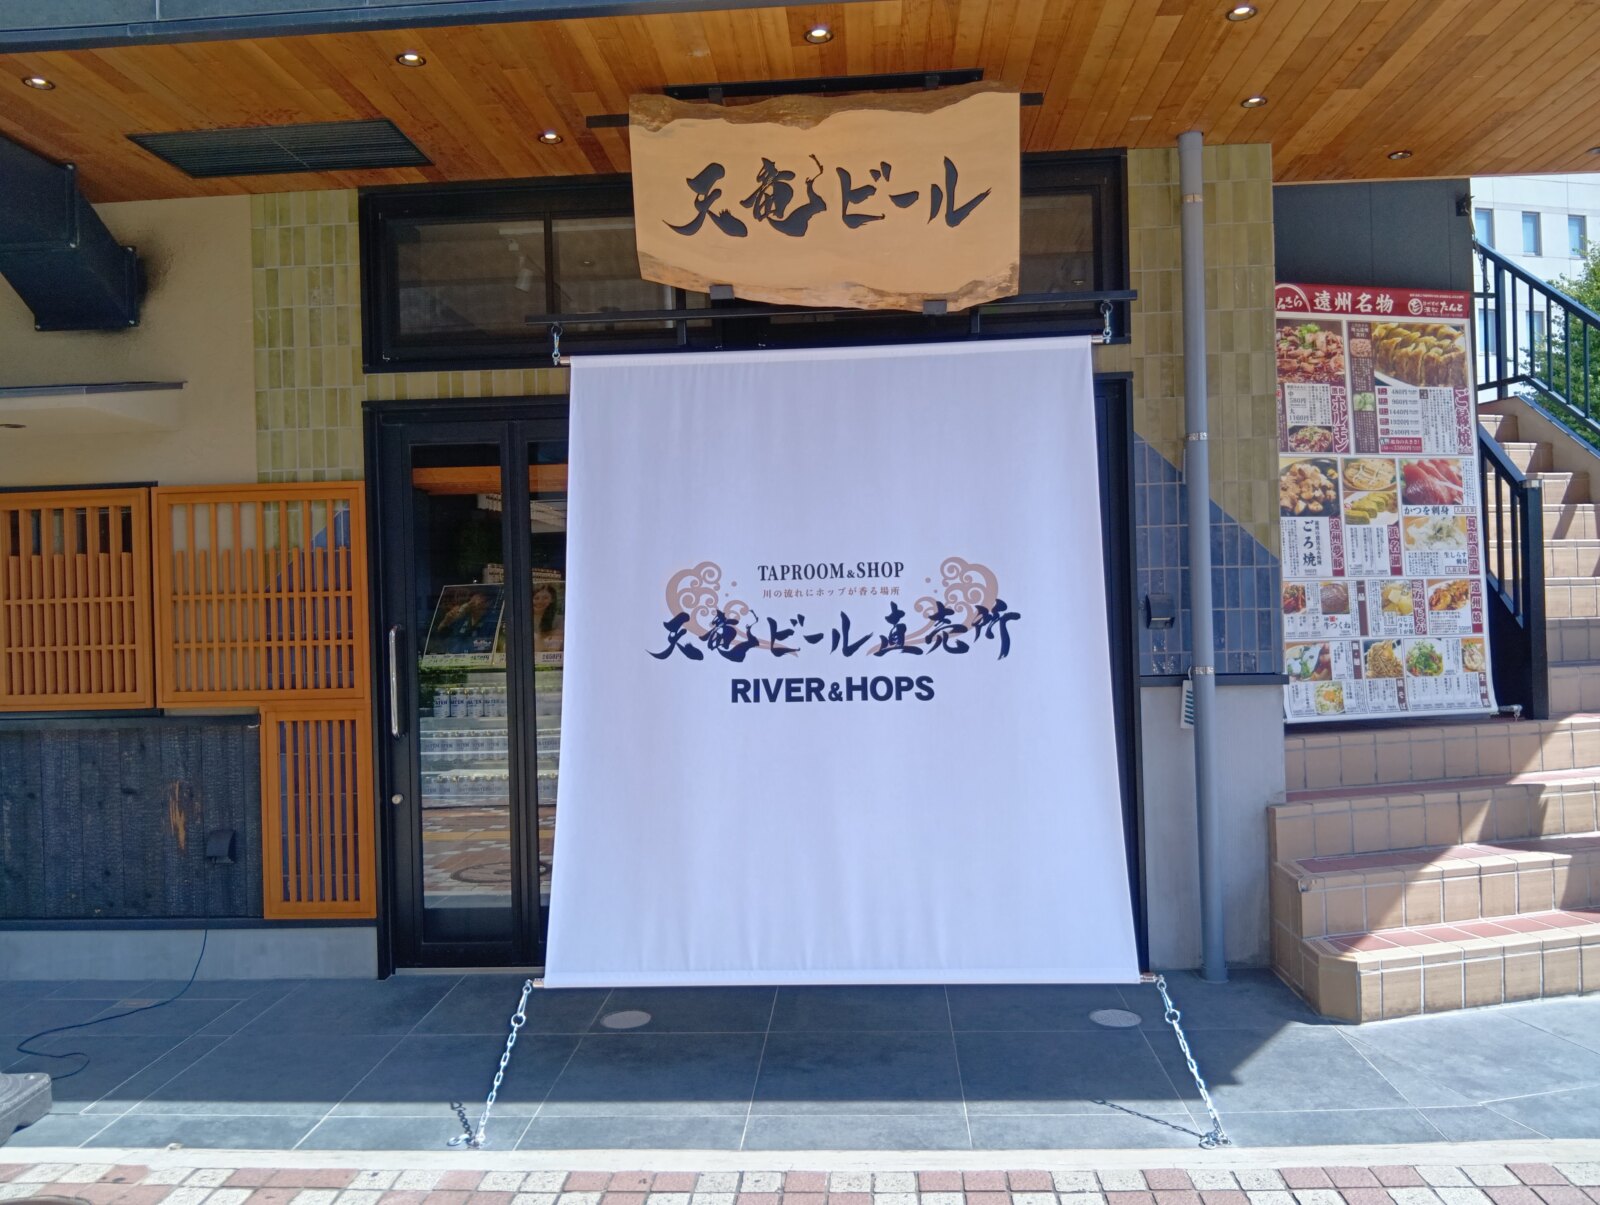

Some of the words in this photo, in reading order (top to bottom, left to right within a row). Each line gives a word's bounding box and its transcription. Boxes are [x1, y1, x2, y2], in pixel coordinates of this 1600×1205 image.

[663, 154, 992, 238] 天竜ビール
[1313, 290, 1394, 313] 遠州名物
[1332, 395, 1349, 452] ホルモン
[1303, 520, 1316, 567] ごろ焼
[757, 561, 905, 582] TAPROOM&SHOP
[762, 586, 901, 599] 川の流れにホップが香る場所
[644, 599, 1021, 663] 天竜ビール直売所
[731, 676, 935, 703] RIVER&HOPS
